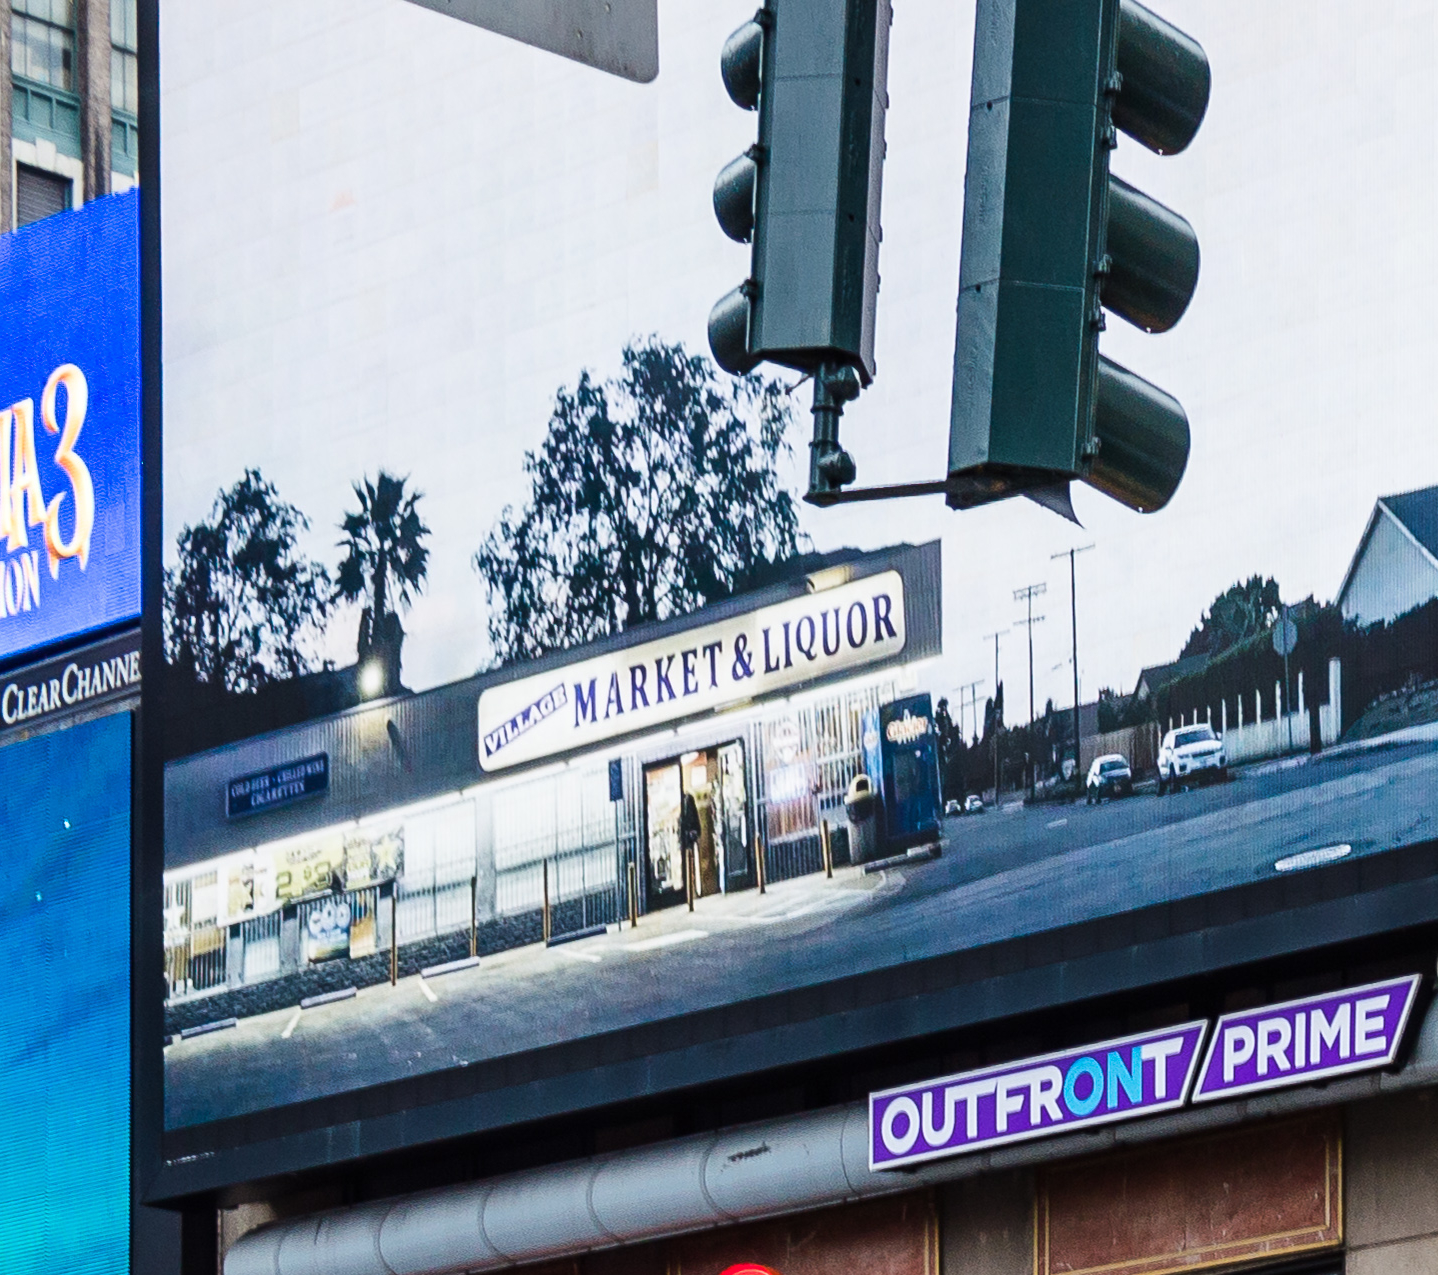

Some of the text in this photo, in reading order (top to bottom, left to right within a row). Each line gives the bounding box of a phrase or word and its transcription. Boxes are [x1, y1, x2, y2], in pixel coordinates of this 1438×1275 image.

[41, 363, 95, 579] 3
[484, 593, 899, 758] VILLAGE MARKET & LIQUOR
[881, 993, 1391, 1156] OUTFRONT PRIME
